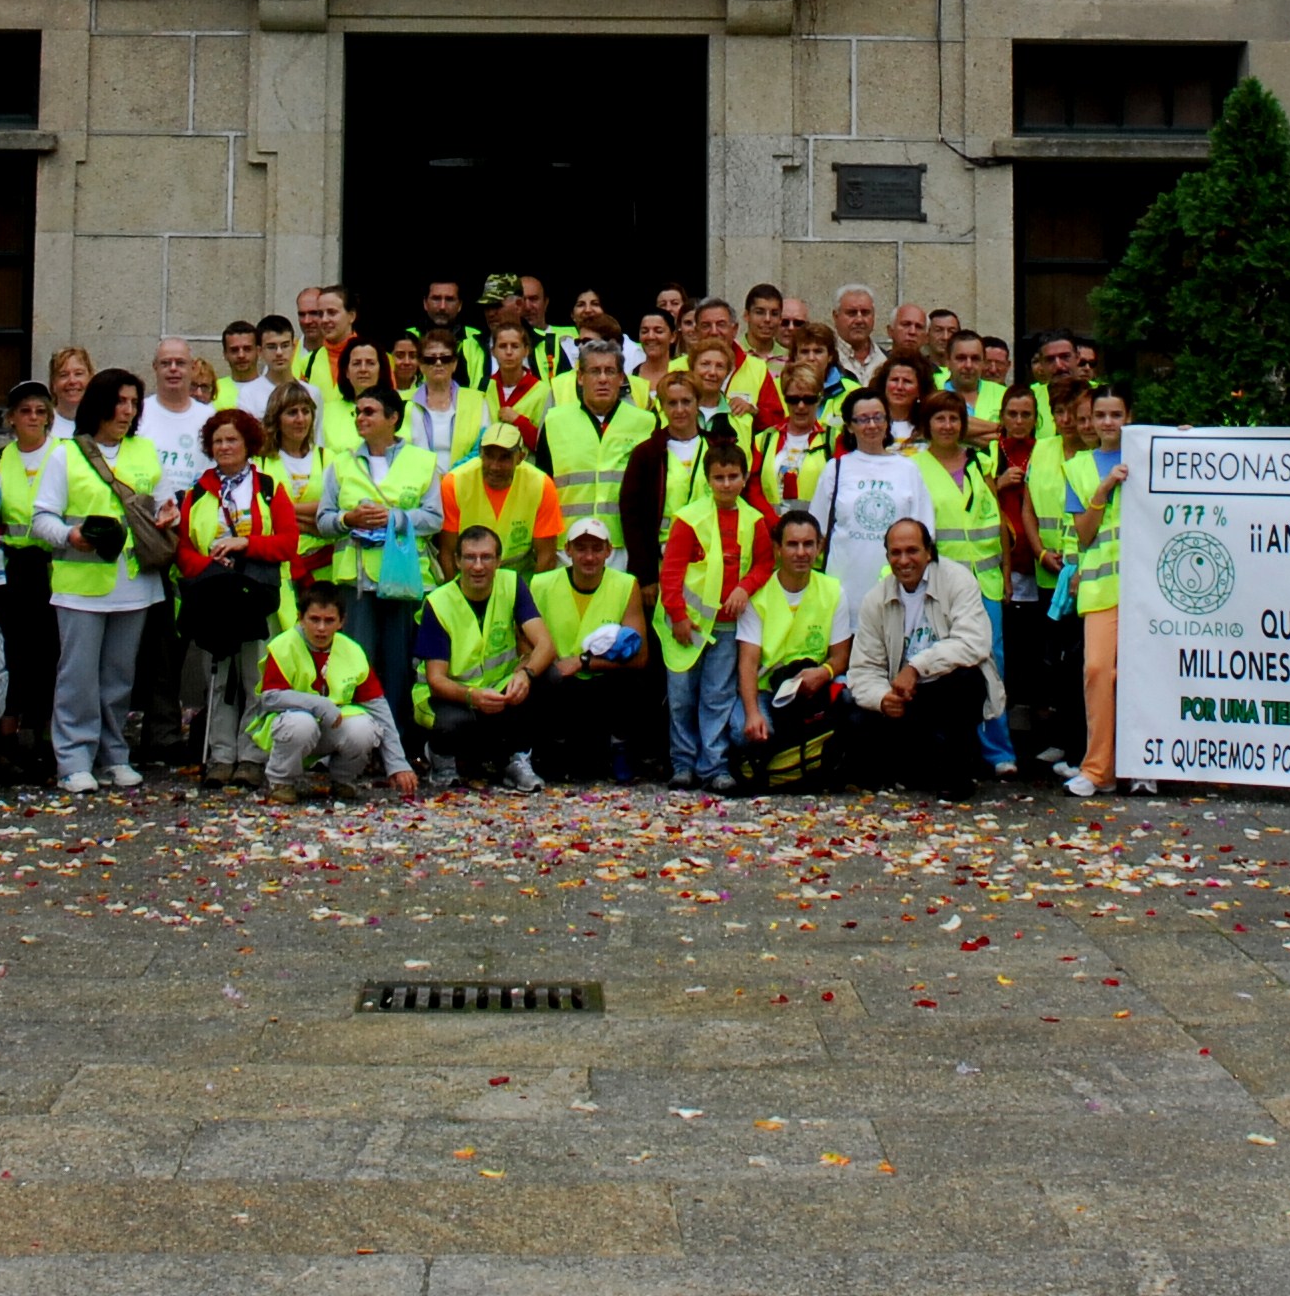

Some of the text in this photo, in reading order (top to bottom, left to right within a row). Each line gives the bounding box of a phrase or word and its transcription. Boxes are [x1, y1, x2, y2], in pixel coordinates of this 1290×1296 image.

[1212, 505, 1227, 527] %
[848, 531, 885, 541] SOLIDA
[1179, 648, 1290, 682] MILLONES
[1180, 696, 1217, 722] POR
[1220, 698, 1259, 725] UNA
[1143, 738, 1164, 765] SI
[1171, 738, 1266, 772] QUEREMOS
